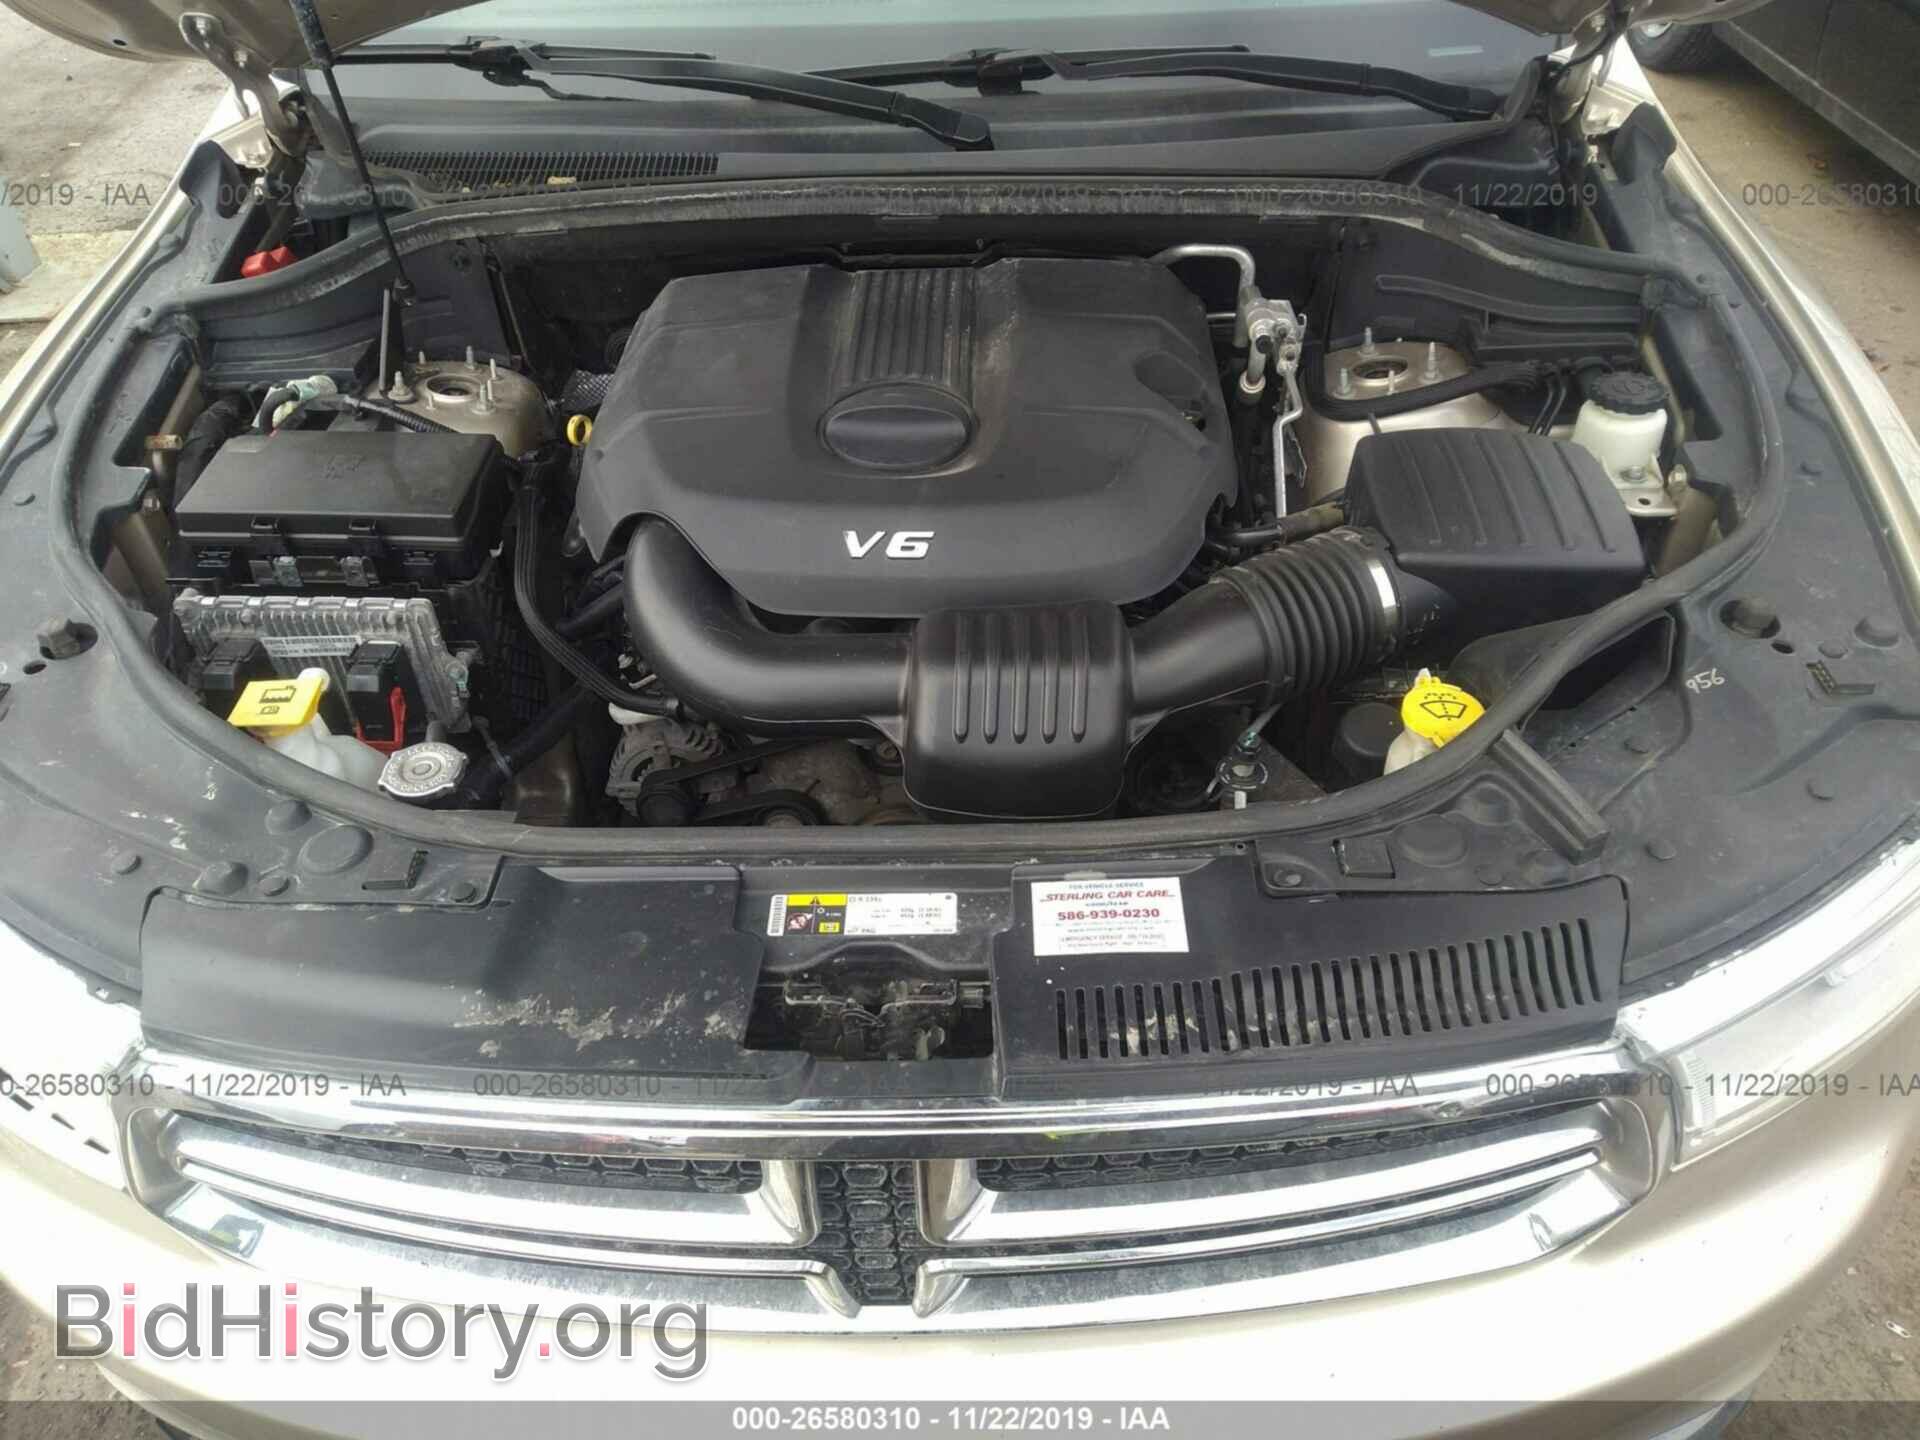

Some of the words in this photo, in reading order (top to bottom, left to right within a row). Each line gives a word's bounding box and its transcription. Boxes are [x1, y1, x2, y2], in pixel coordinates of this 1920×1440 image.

[842, 530, 935, 559] V6
[1685, 667, 1725, 694] 956
[1046, 891, 1104, 901] STERLING
[1107, 890, 1133, 900] CAR
[1136, 889, 1169, 898] CARE
[1057, 908, 1160, 921] 586-939-0230
